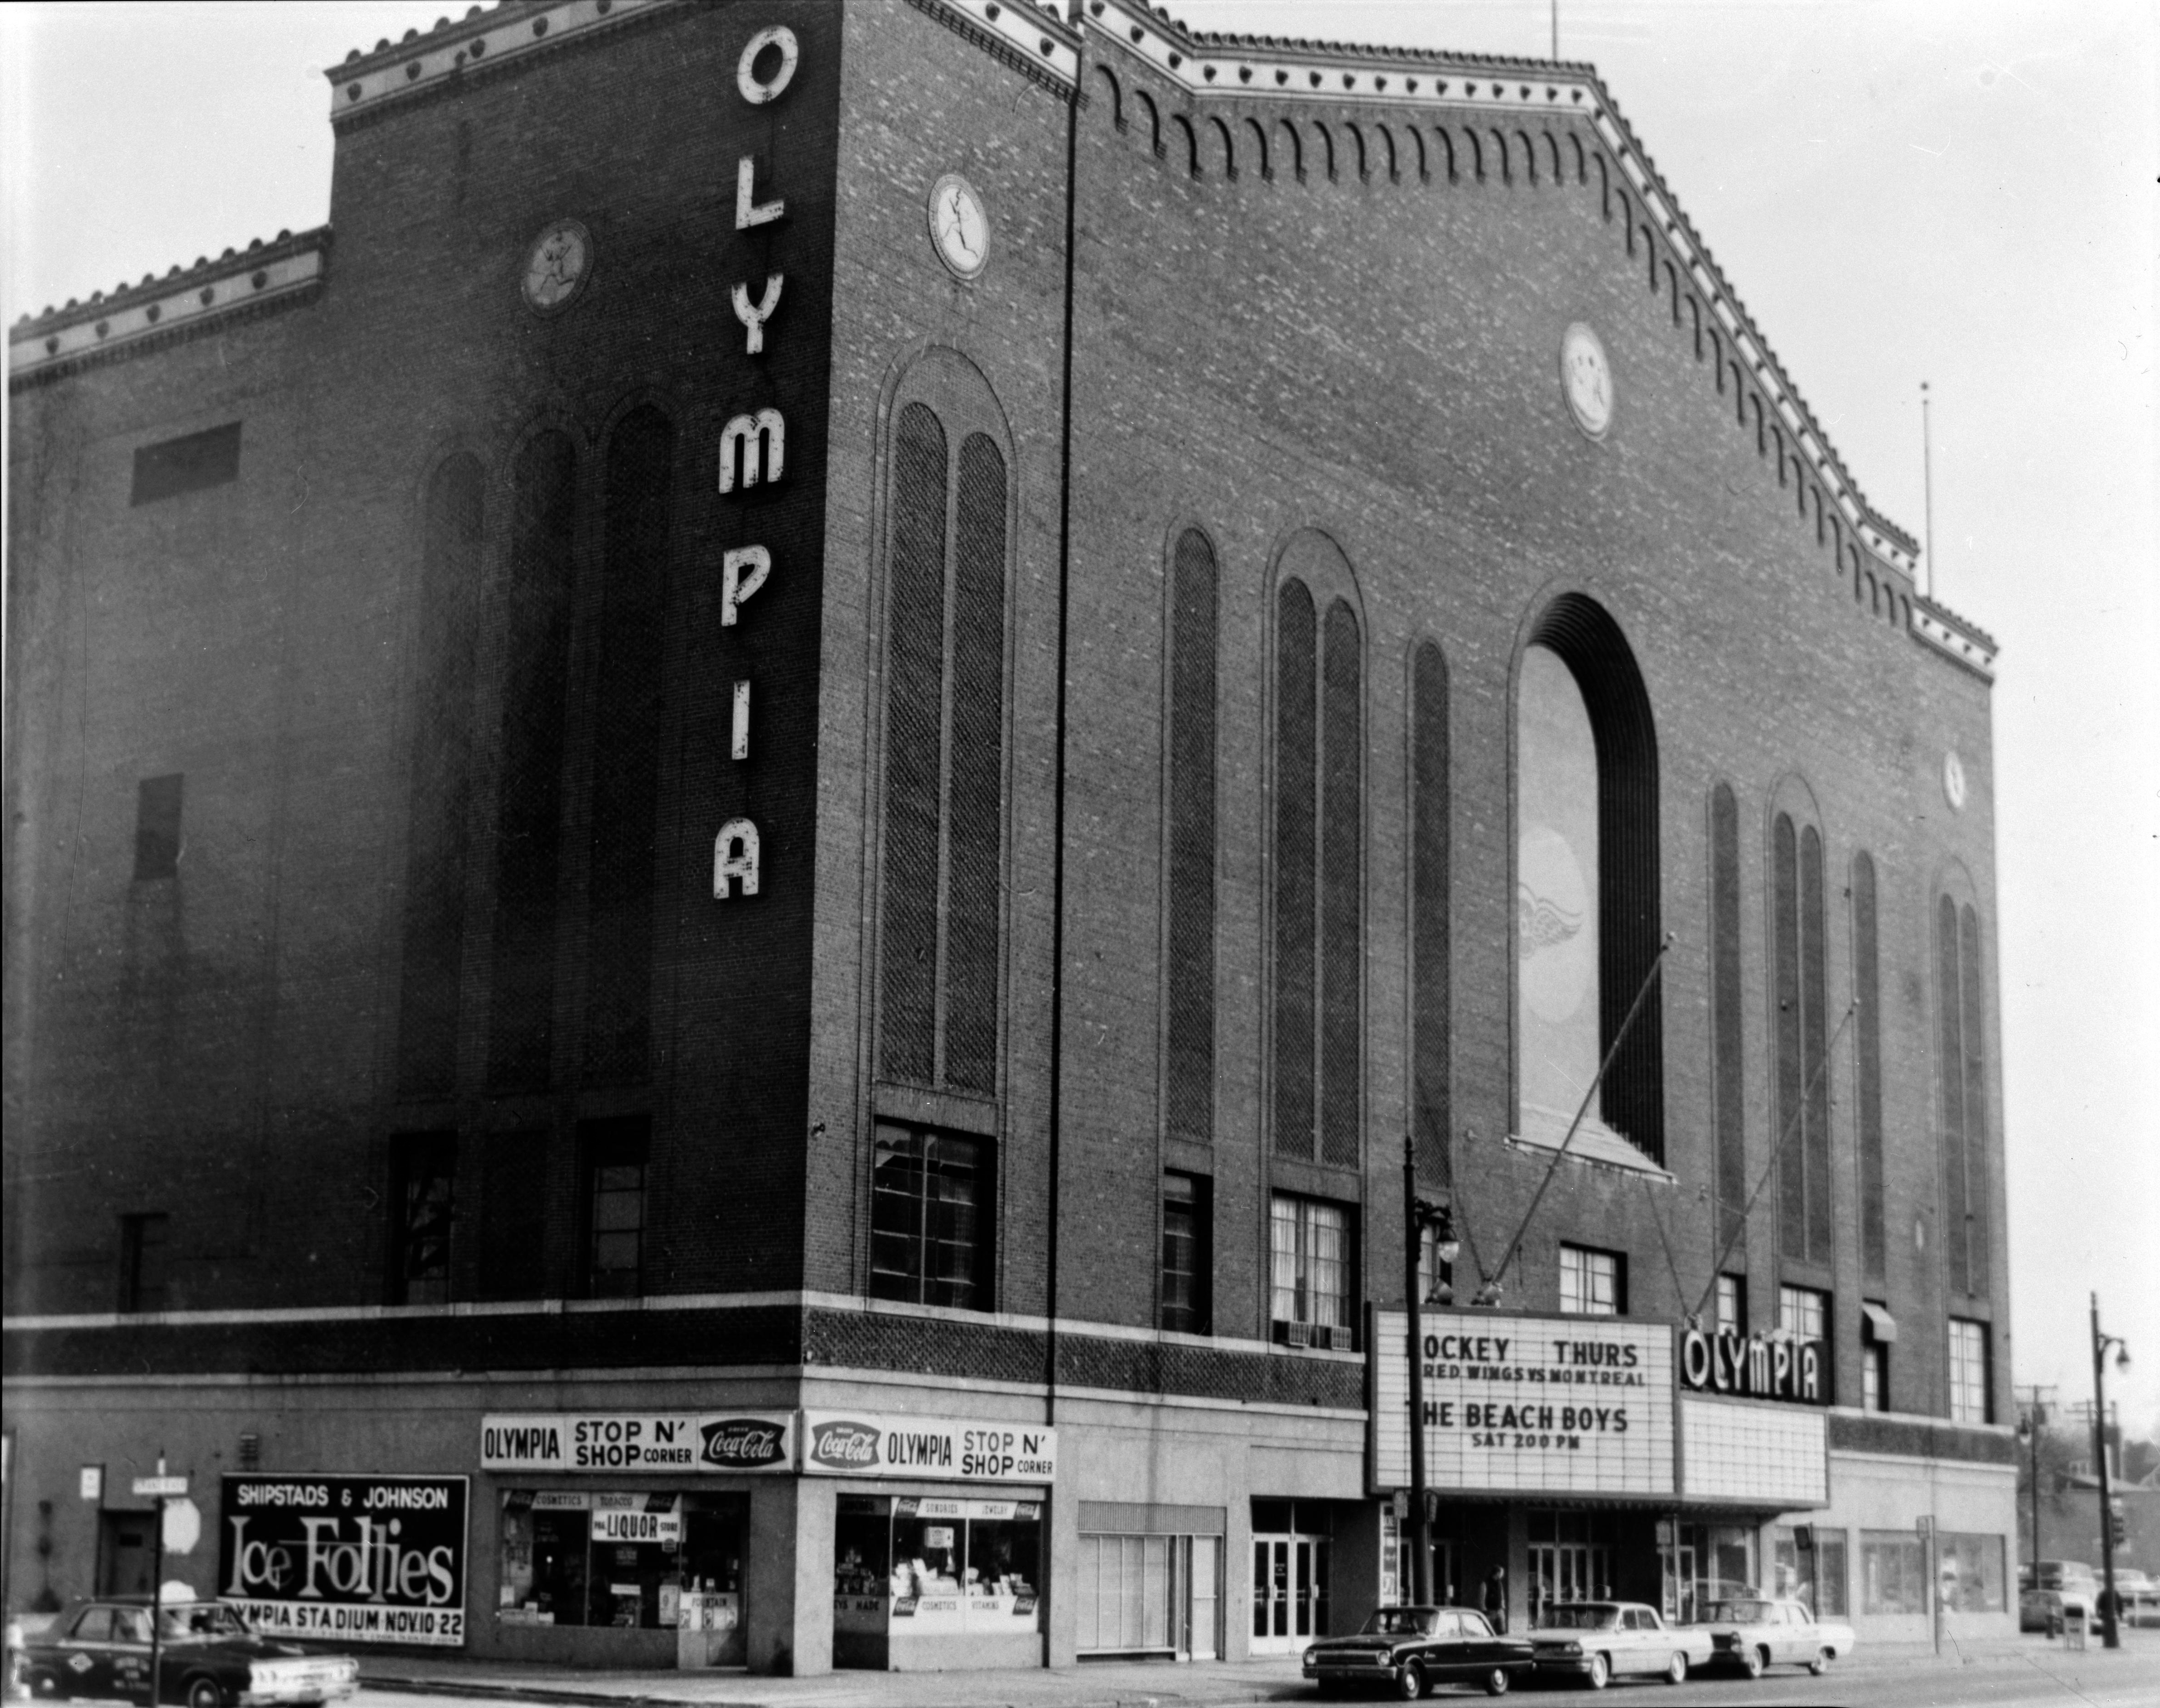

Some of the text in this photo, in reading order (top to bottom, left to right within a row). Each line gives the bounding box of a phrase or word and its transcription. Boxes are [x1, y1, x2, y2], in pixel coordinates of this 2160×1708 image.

[713, 25, 799, 899] OLYMPIA
[1406, 1334, 1638, 1367] OCKEY THURS
[1423, 1363, 1646, 1387] RED WINGS VS MONTREAL
[1684, 1329, 1818, 1399] OLYMPIA
[1405, 1401, 1628, 1432] HE BEACH BOYS
[485, 1428, 560, 1459] OLYMPIA
[575, 1421, 685, 1443] STOP N'
[709, 1430, 776, 1459] Coca-Cola
[964, 1430, 1045, 1454] STOP N'
[1472, 1432, 1580, 1449] SAT 200 PM
[576, 1445, 692, 1466] SHOP CORNER
[888, 1432, 951, 1466] OLYMPIA
[962, 1454, 1053, 1476] SHOP CORNER
[237, 1484, 448, 1508] SHIPSTADS & JOHNSON
[536, 1496, 581, 1505] COSMETICS
[600, 1496, 633, 1506] TOBACCO
[607, 1514, 658, 1539] LIQUOR
[660, 1522, 678, 1532] STORE
[226, 1516, 294, 1596] Ice
[297, 1606, 379, 1630] STADIUM
[440, 1613, 462, 1634] 22
